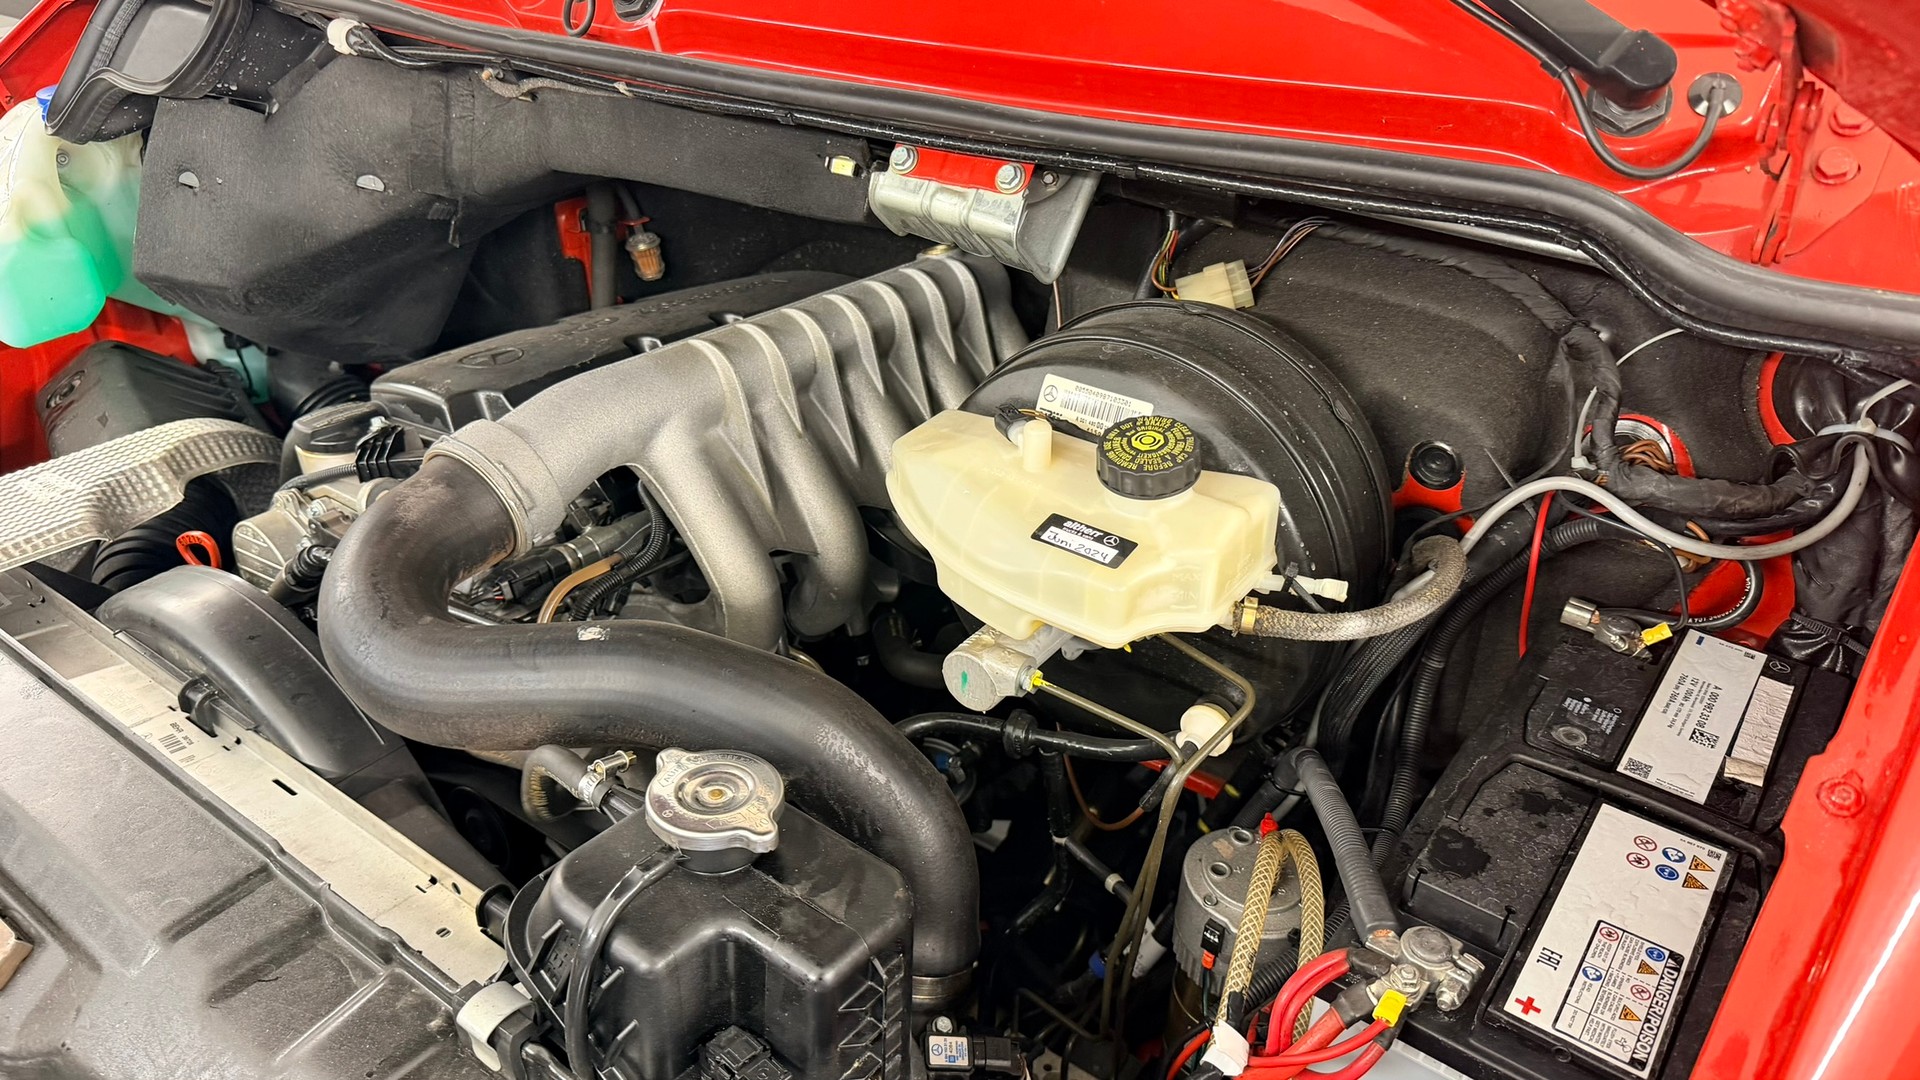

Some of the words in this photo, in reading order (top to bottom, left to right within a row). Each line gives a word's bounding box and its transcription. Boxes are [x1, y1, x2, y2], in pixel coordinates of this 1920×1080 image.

[1106, 450, 1138, 470] REMOVING
[1143, 461, 1173, 470] BEFORE
[1062, 520, 1103, 537] altherr
[1047, 530, 1072, 547] Juni
[1074, 543, 1108, 561] 2024
[1676, 672, 1688, 686] 760A
[1688, 676, 1700, 687] 12V
[1667, 690, 1680, 703] 760A
[1680, 687, 1694, 703] 100Ah
[1706, 690, 1720, 703] 000
[1702, 701, 1715, 713] 982
[1698, 711, 1710, 721] 33
[1694, 719, 1706, 729] 08
[1631, 966, 1678, 1063] DANGER/POISON
